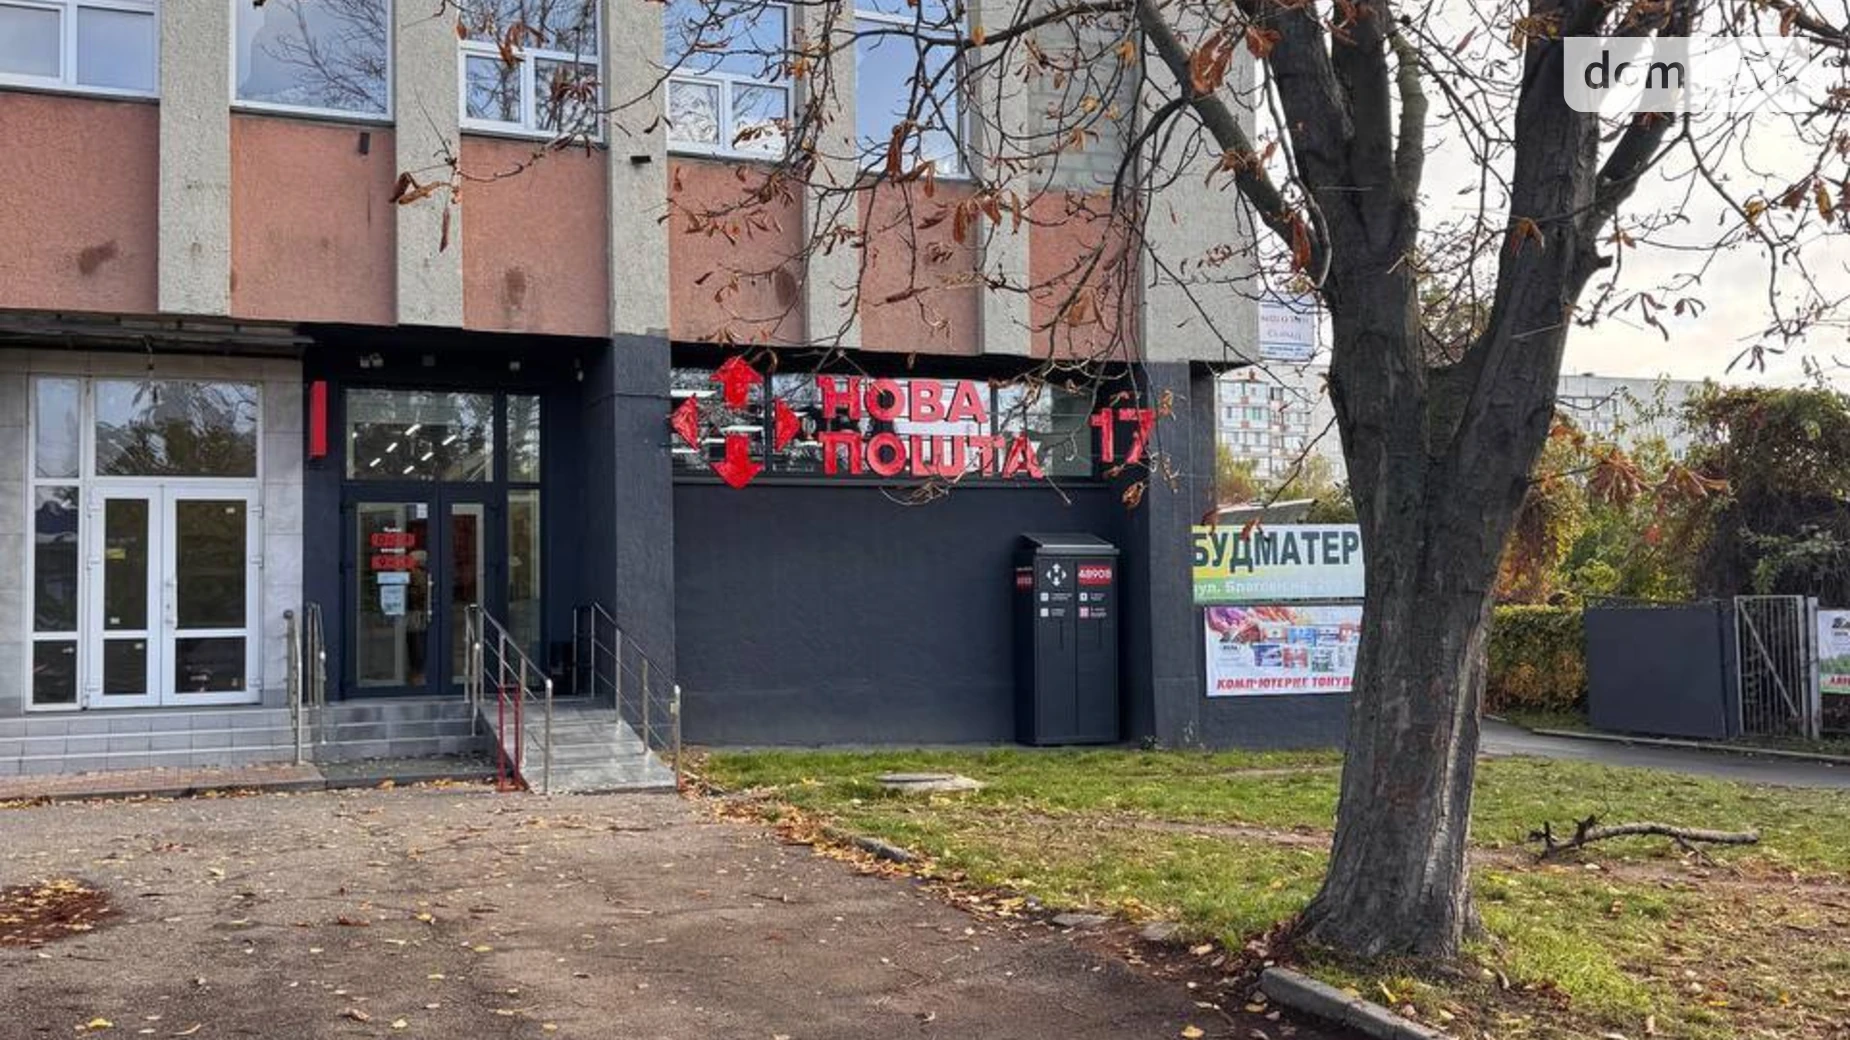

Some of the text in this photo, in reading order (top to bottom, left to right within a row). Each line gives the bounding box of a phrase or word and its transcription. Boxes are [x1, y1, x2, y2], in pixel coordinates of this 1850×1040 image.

[817, 375, 987, 423] НОВА
[818, 431, 1045, 479] ПОШТА
[1091, 407, 1155, 464] 17
[1193, 531, 1359, 573] БУДМАТЕР
